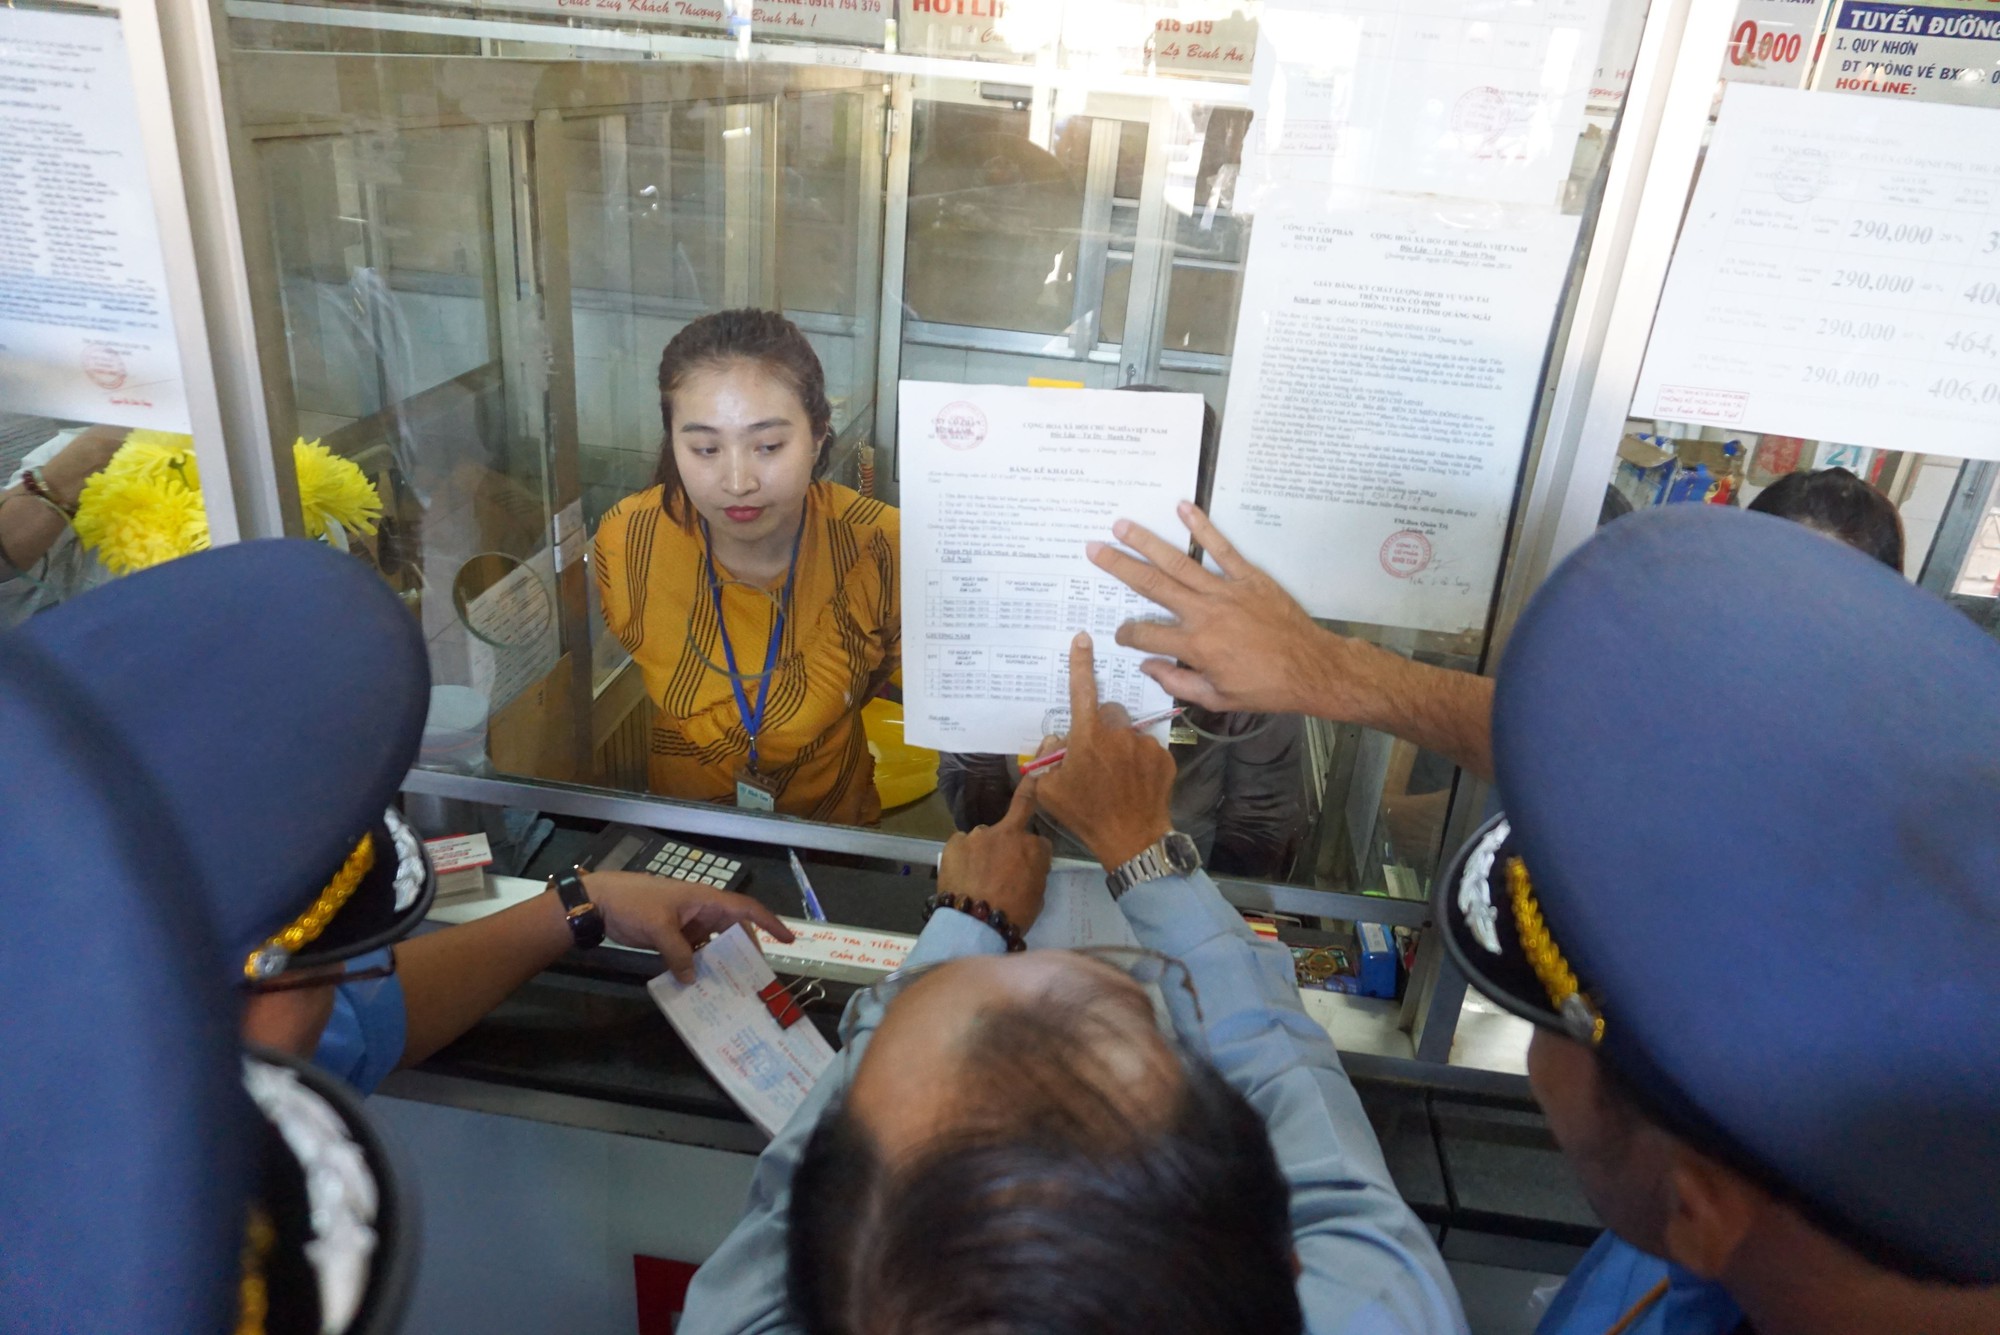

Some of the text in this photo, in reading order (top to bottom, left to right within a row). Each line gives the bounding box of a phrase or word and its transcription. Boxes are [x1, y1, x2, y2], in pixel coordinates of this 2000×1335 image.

[861, 1, 881, 13] 379
[1850, 8, 1925, 34] TUYẾN
[1836, 37, 1919, 56] 1. QUY NHƠN
[1841, 60, 1861, 73] ĐT
[1917, 63, 1936, 79] VÉ
[1835, 78, 1918, 95] HOTLINE:
